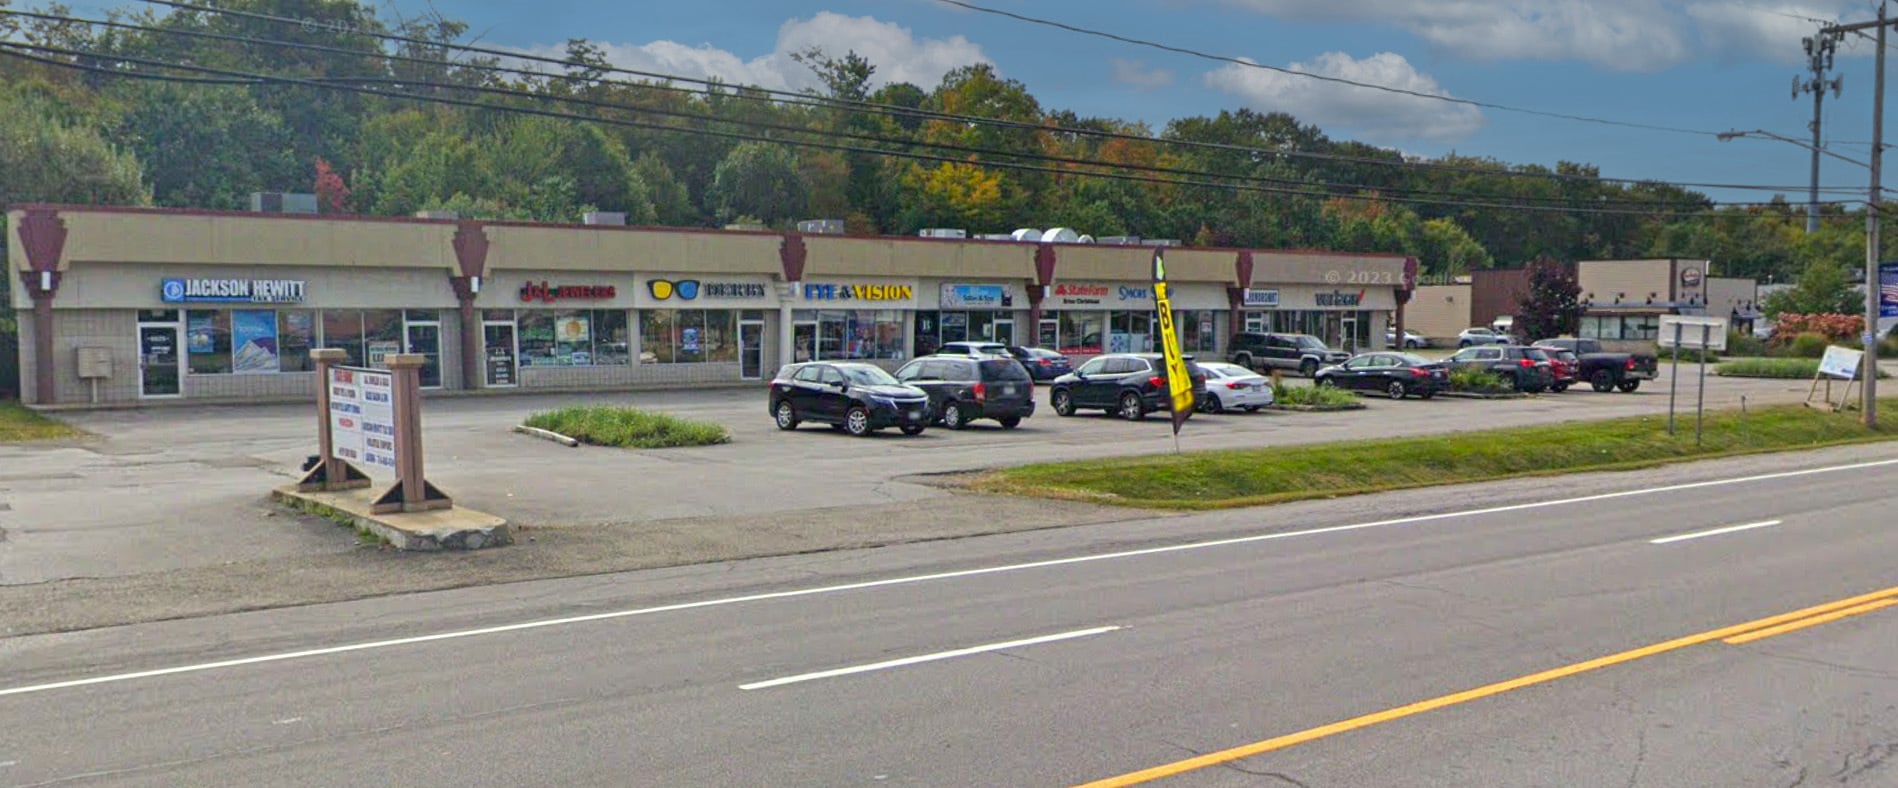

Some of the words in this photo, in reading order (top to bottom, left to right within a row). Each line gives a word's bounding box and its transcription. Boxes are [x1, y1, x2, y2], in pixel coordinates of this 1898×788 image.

[185, 278, 249, 296] JACKSON
[253, 279, 305, 297] HEWITT
[703, 282, 766, 298] DERBY
[805, 283, 838, 300] EYE
[839, 285, 852, 299] &
[853, 284, 912, 300] VISION
